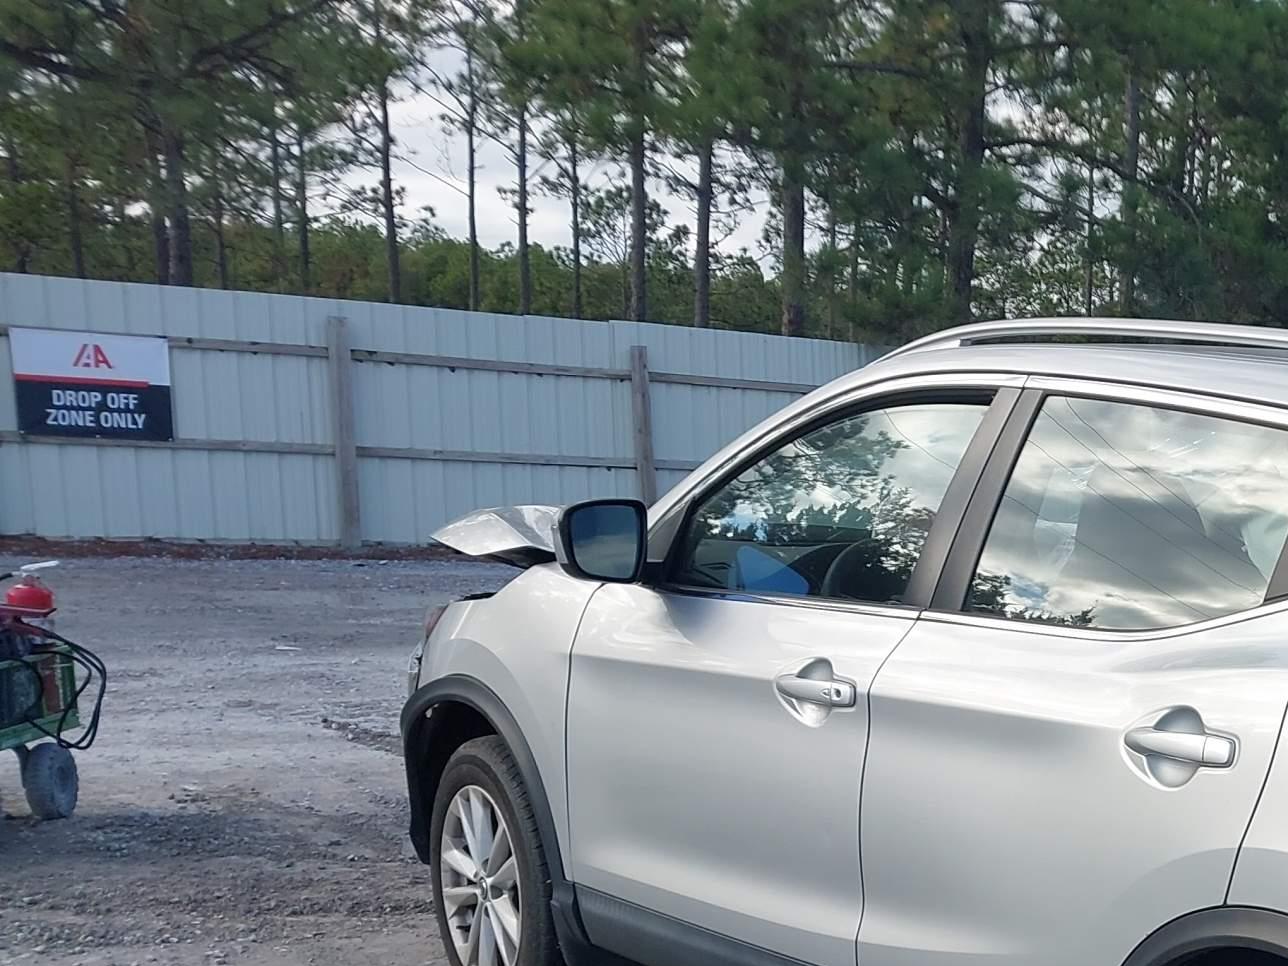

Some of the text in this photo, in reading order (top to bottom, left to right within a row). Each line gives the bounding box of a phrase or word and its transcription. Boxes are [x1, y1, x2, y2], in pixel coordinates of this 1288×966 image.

[52, 389, 139, 410] DROP OFF
[46, 408, 147, 429] ZONE ONLY
